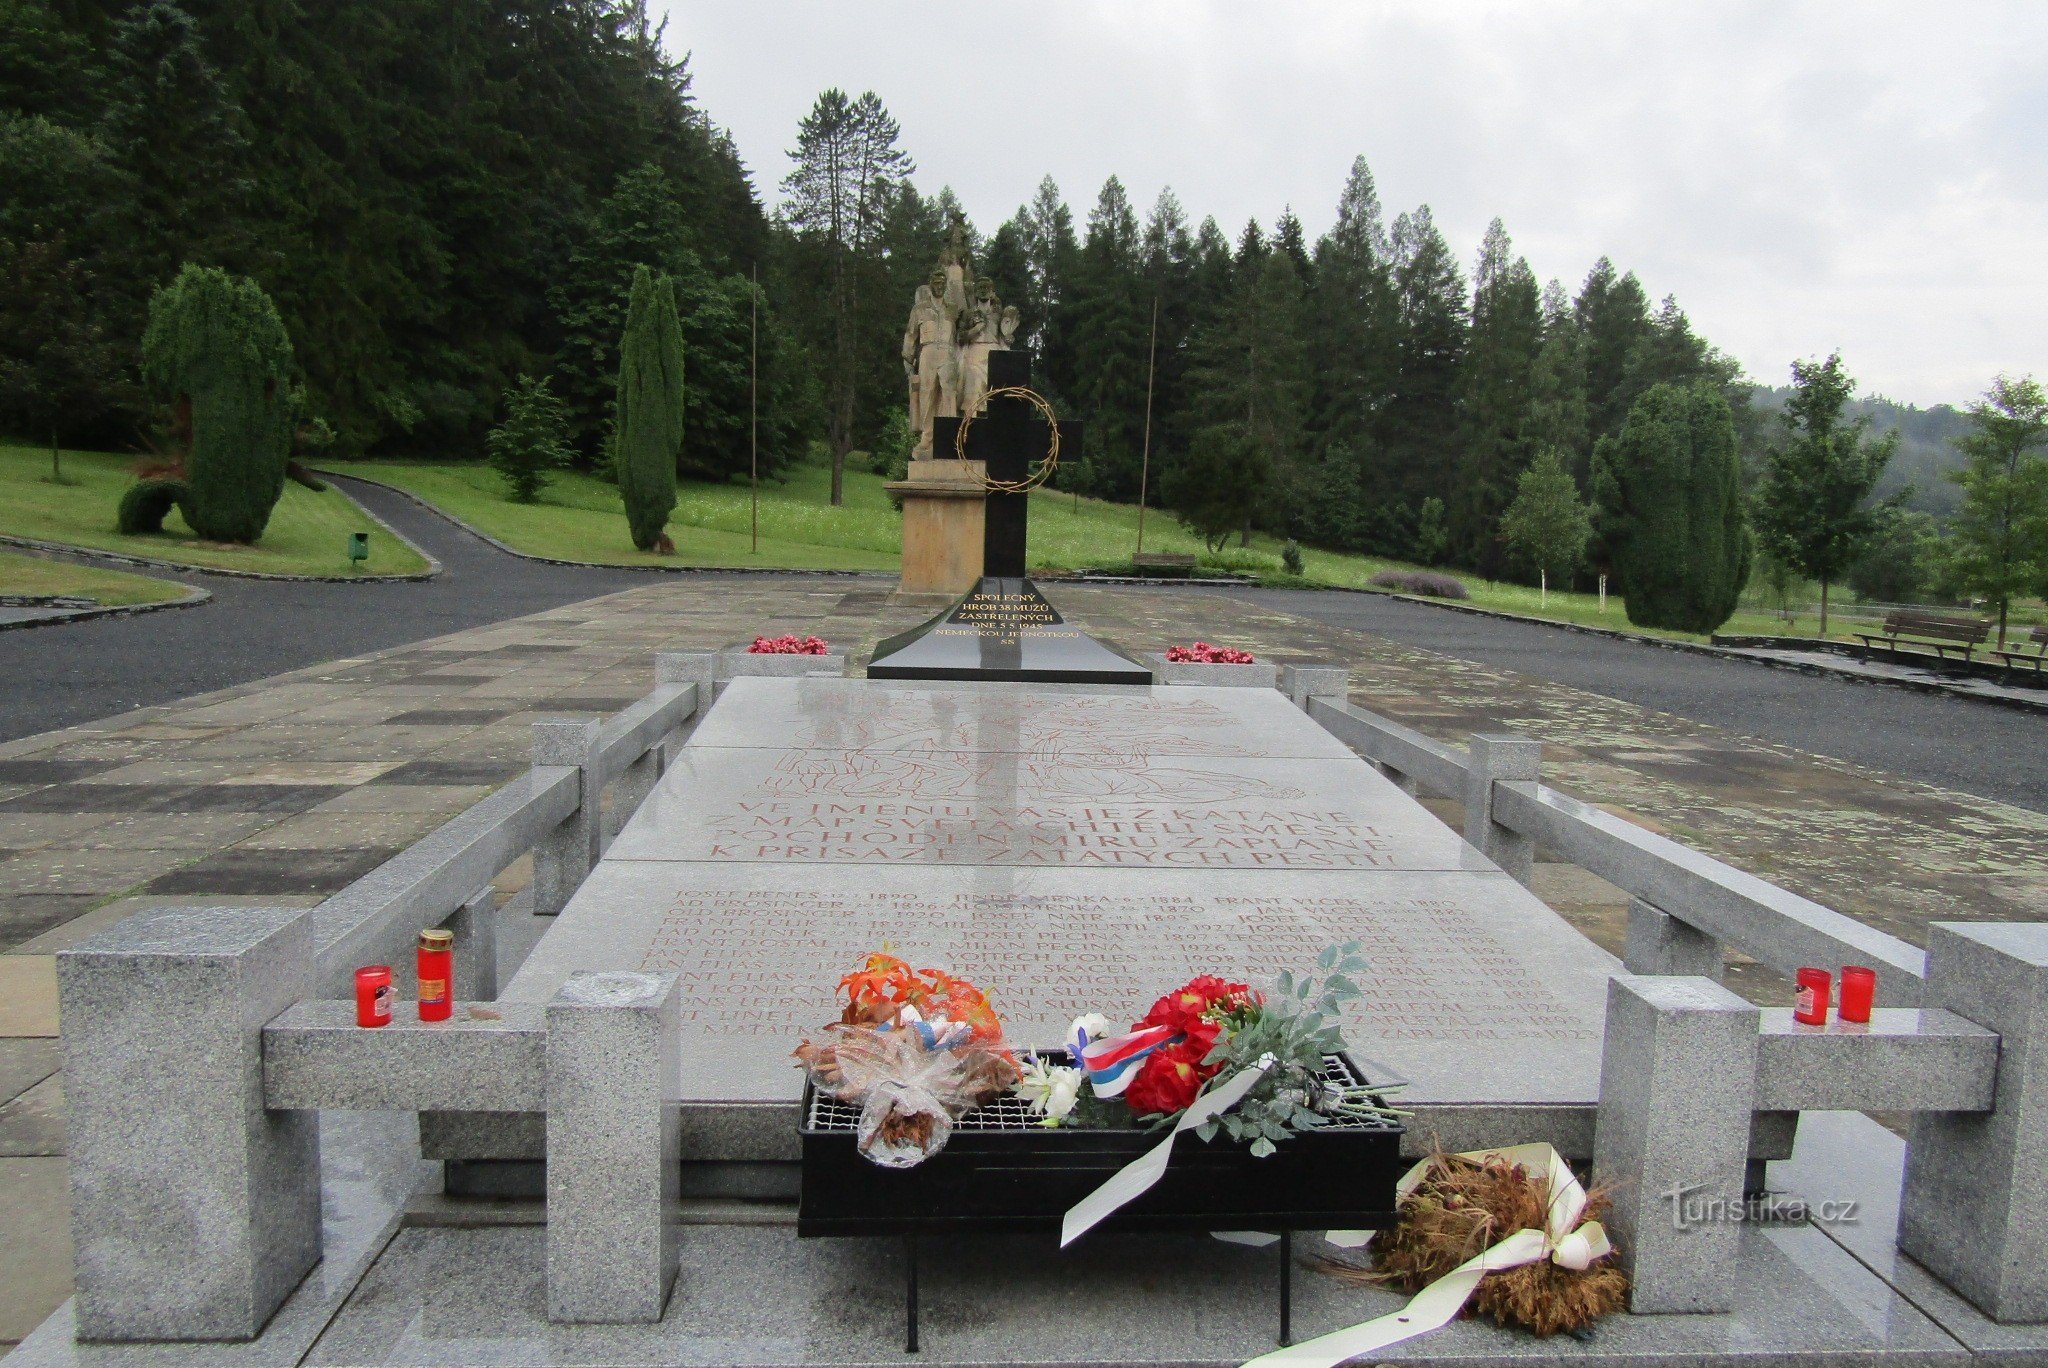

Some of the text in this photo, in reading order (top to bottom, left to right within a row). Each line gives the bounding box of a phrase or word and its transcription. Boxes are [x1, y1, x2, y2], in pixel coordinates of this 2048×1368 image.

[962, 603, 997, 611] HROB
[1013, 603, 1049, 612] MUŽŮ
[971, 621, 997, 629] DNE
[1007, 630, 1079, 638] JEDNOTKOU
[739, 802, 791, 814] VE
